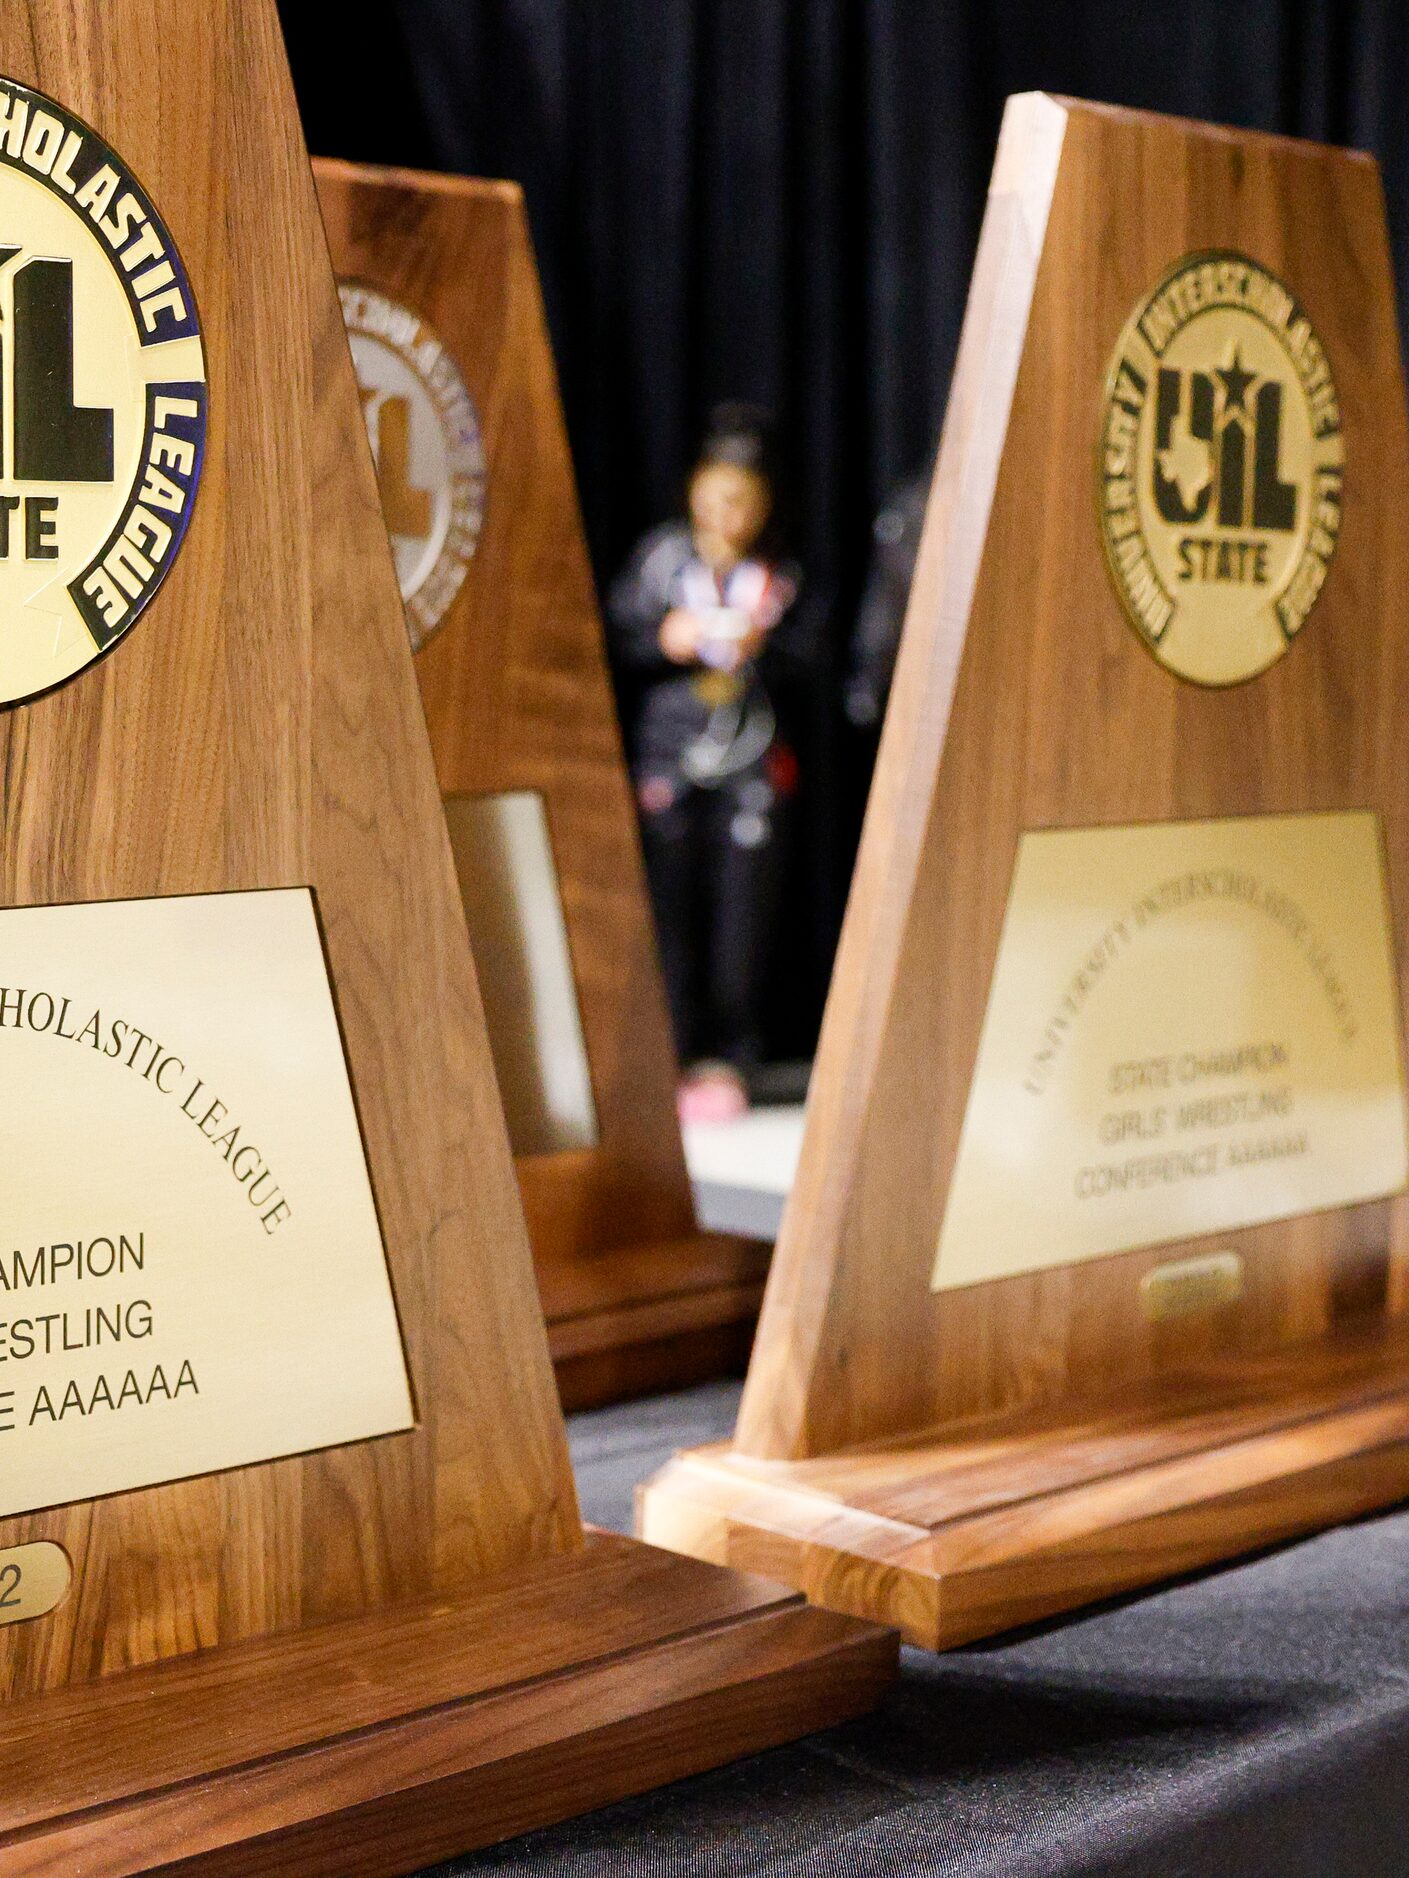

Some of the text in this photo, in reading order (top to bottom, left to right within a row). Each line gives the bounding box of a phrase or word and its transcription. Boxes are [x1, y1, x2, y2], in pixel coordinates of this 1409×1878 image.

[82, 395, 199, 629] LEAGUE
[1178, 538, 1270, 584] STATE
[178, 1078, 292, 1237] LEAGUE
[28, 1358, 200, 1427] AAAAAA
